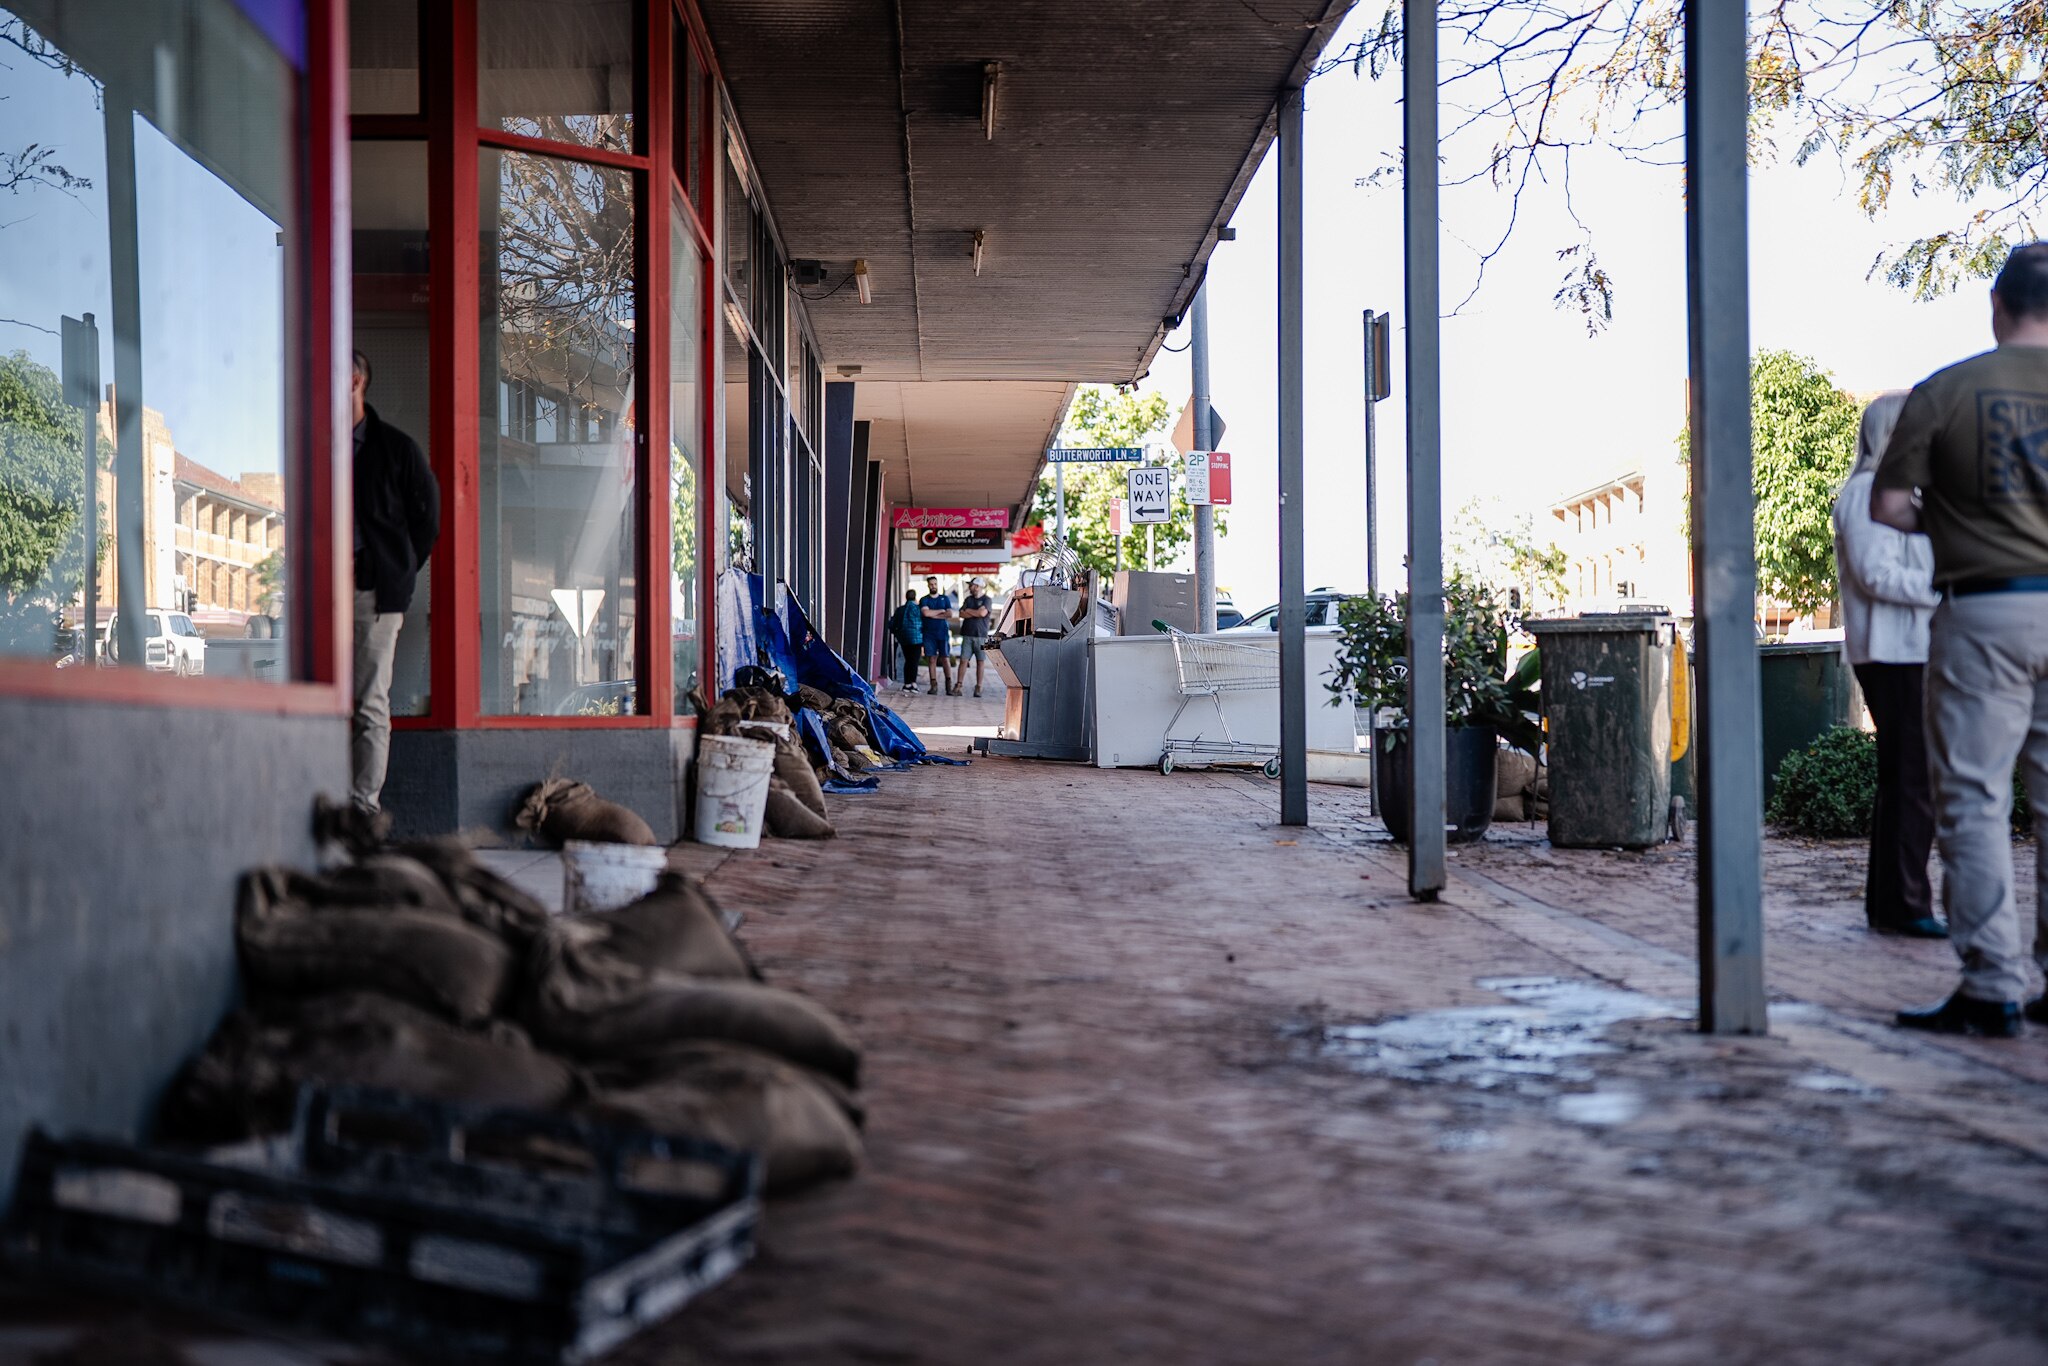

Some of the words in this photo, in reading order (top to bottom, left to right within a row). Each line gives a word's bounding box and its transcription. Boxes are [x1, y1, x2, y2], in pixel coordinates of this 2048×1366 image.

[1050, 449, 1112, 461] BUTTERWORTH
[1115, 449, 1127, 461] LN
[1189, 454, 1205, 466] 2P
[1135, 473, 1163, 486] ONE
[1133, 489, 1165, 503] WAY
[895, 508, 967, 527] Admire
[937, 529, 976, 538] CONCEPT
